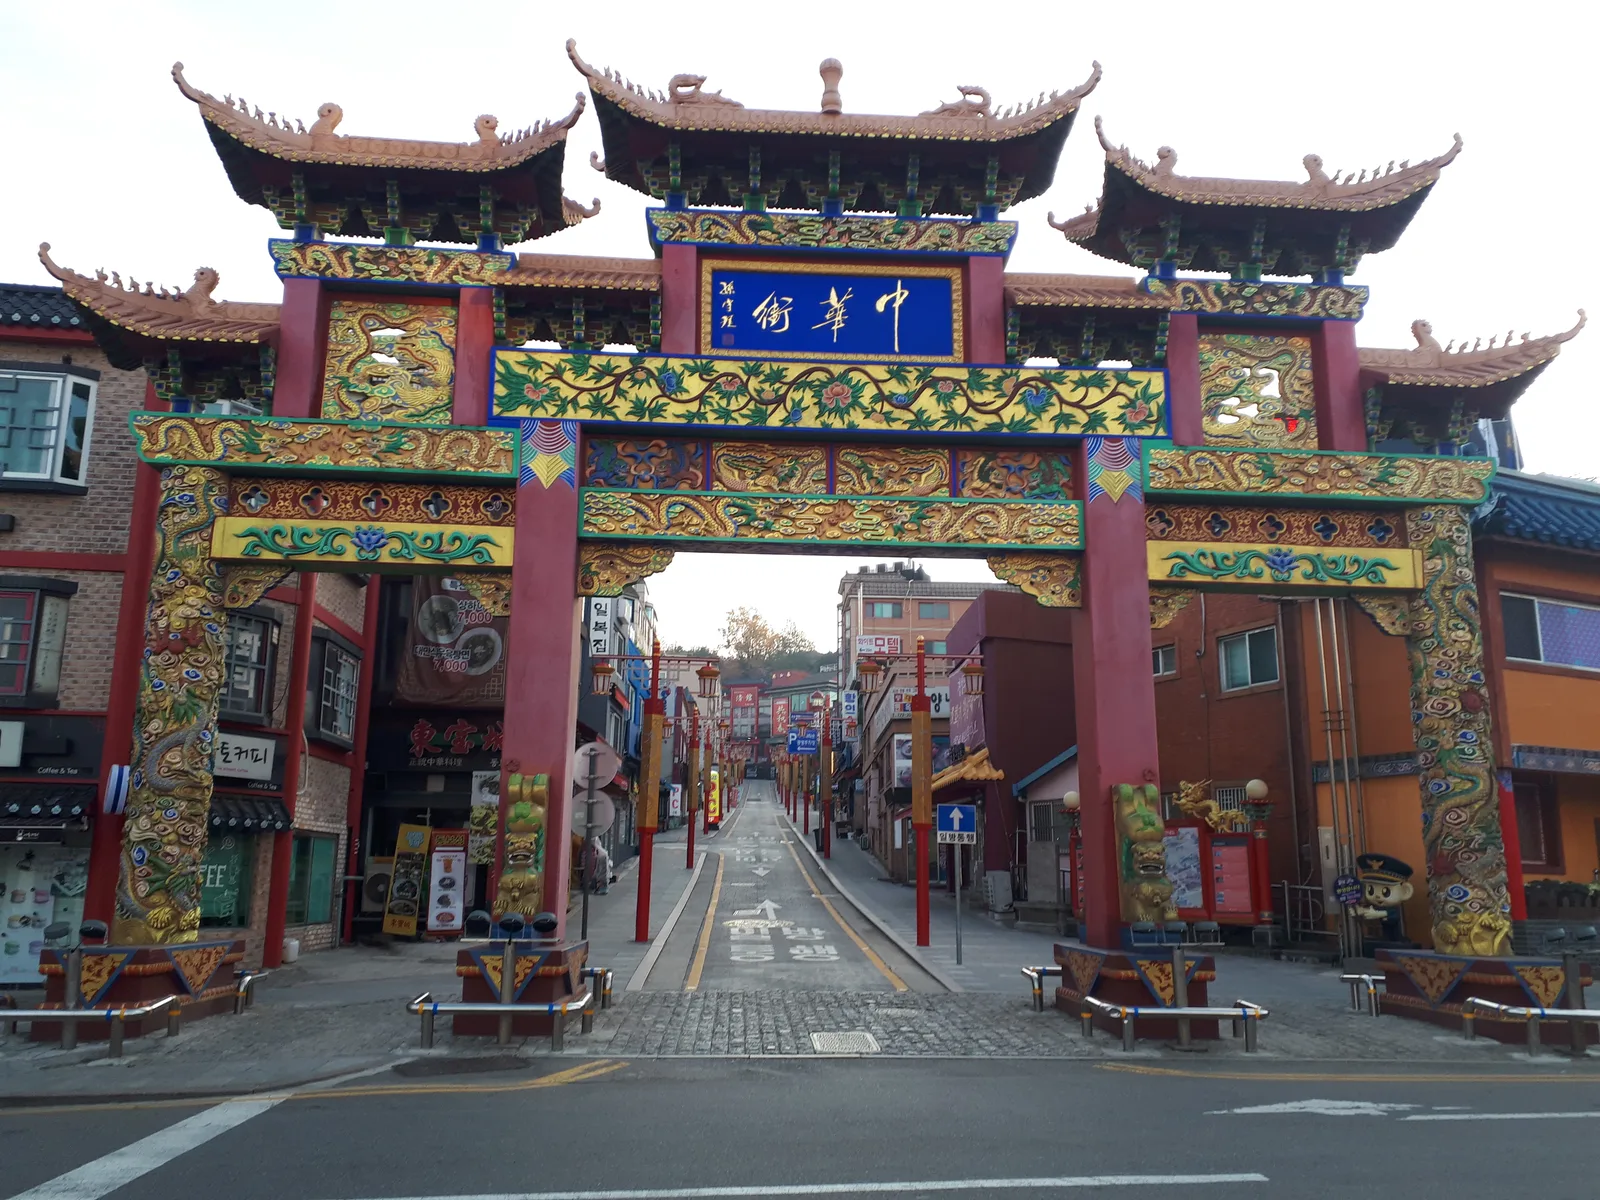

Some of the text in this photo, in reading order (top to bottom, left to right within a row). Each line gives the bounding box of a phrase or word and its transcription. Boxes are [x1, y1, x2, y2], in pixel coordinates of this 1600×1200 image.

[457, 611, 493, 625] 7,000
[592, 602, 608, 653] 일복집
[433, 658, 469, 673] 7,000
[37, 766, 59, 775] Coffee
[939, 832, 975, 843] 일방통행
